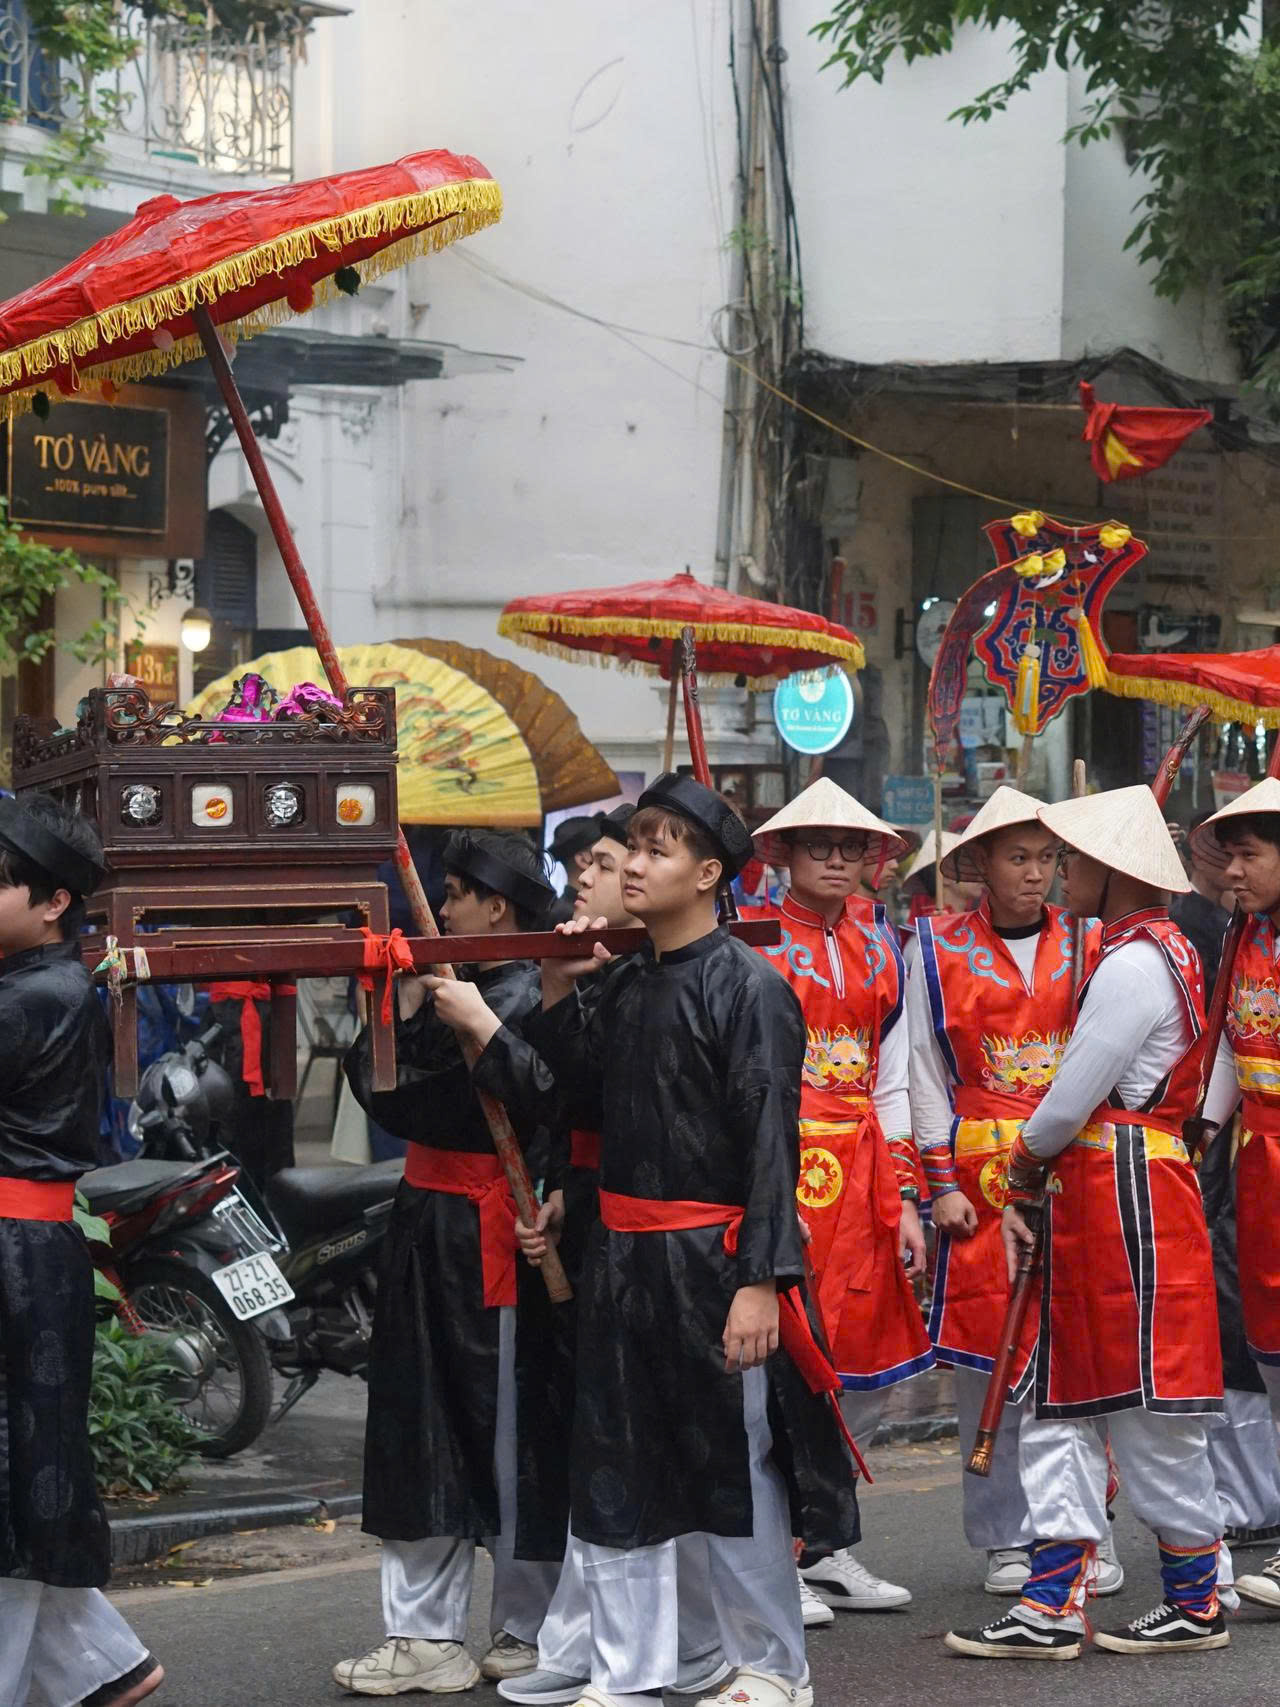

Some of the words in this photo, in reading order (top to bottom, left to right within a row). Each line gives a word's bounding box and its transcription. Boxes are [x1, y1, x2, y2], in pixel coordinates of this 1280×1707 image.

[33, 433, 75, 469] TƠ
[80, 433, 151, 477] VÀNG
[781, 707, 800, 721] TƠ
[803, 707, 842, 723] VÀNG
[232, 1277, 288, 1315] 068.35
